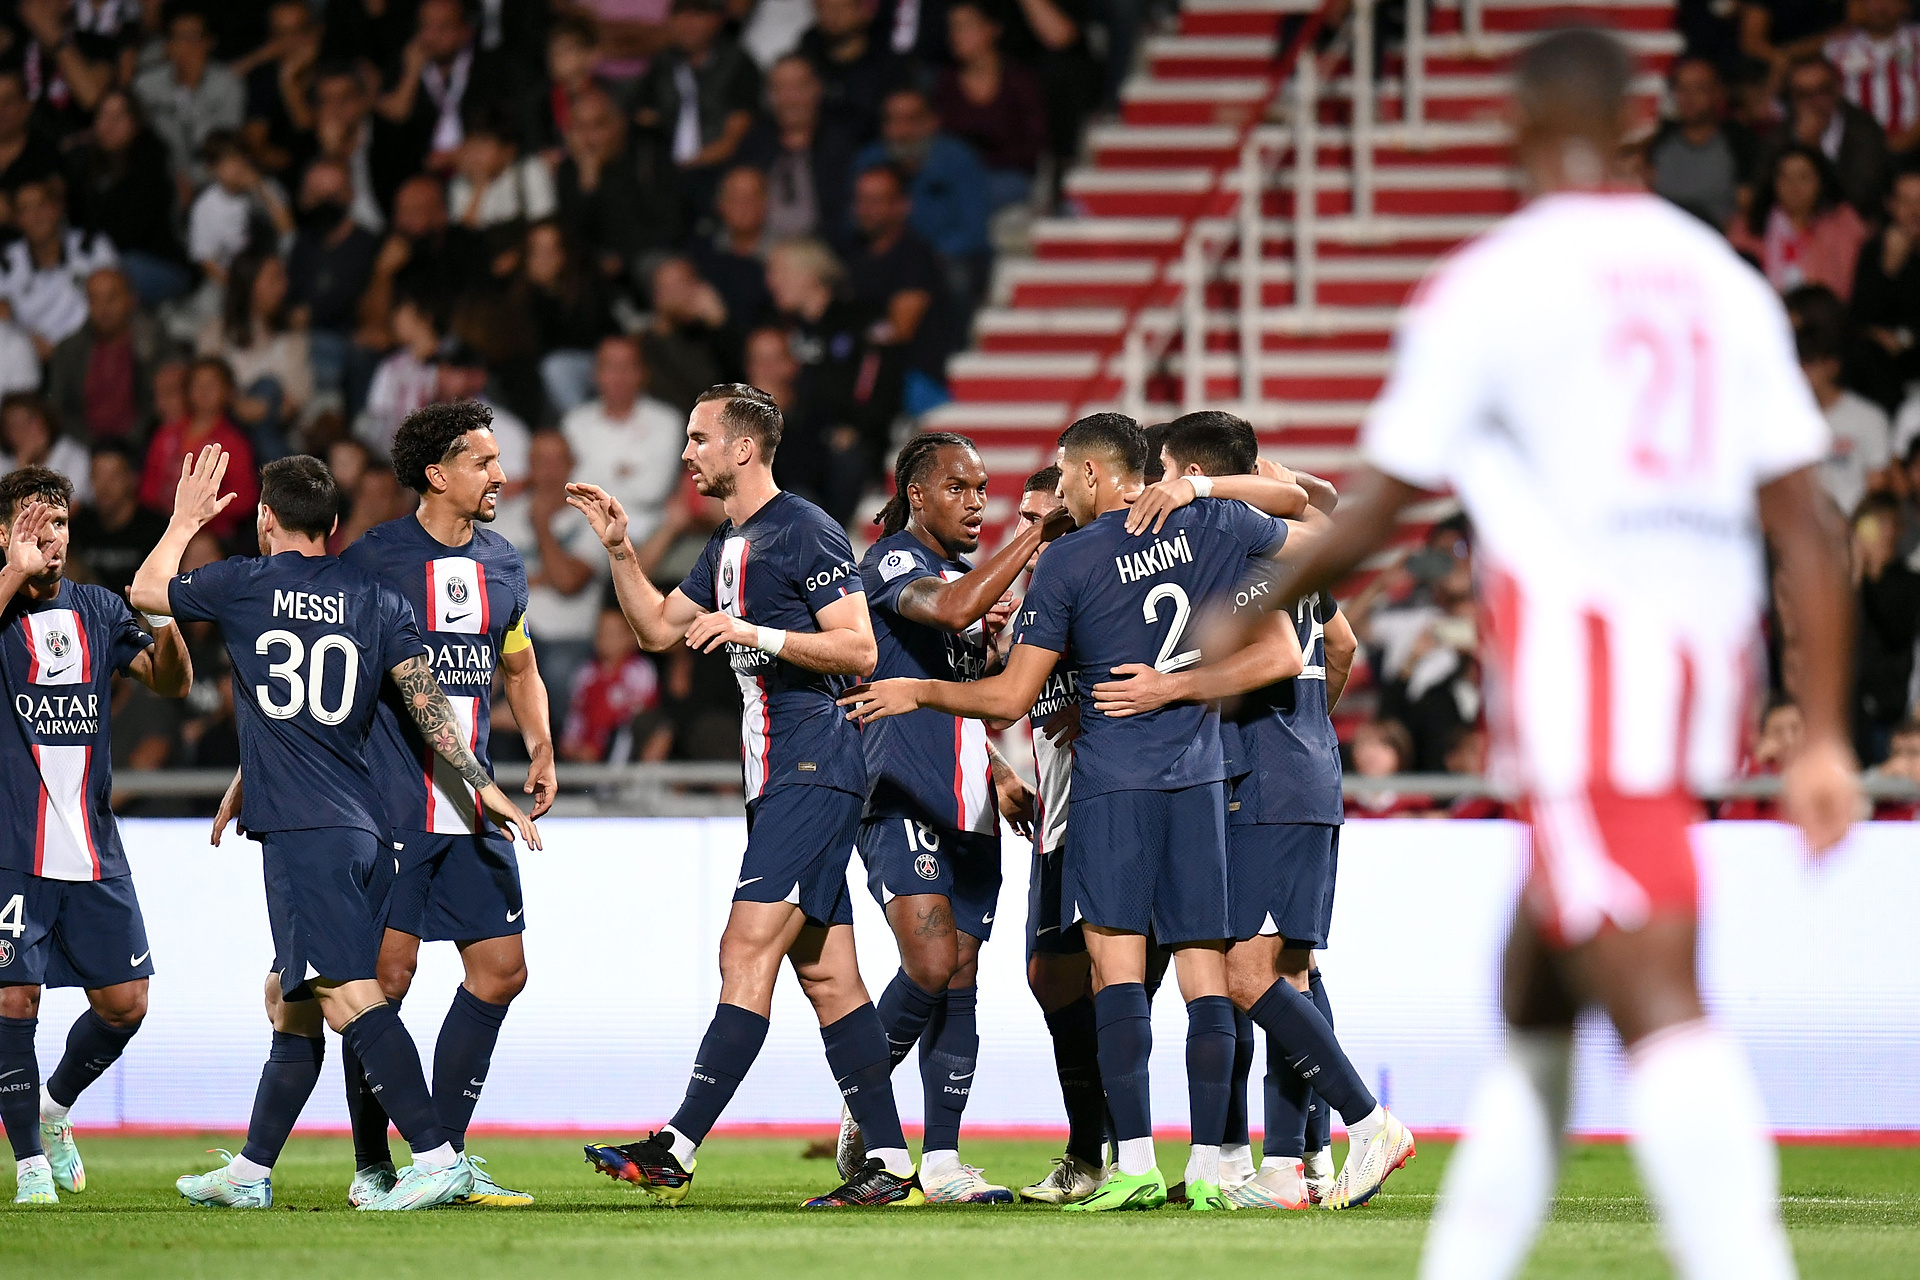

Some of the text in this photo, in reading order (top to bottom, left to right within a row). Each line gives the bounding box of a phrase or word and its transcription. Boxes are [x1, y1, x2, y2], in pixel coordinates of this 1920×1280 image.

[806, 561, 850, 592] GOAT
[1143, 583, 1202, 675] 2
[255, 629, 359, 726] 30
[436, 670, 492, 686] AIRWAYS
[15, 693, 99, 723] QATAR
[35, 719, 99, 735] AIRWAYS
[0, 894, 26, 938] 4
[842, 1085, 859, 1096] RIS
